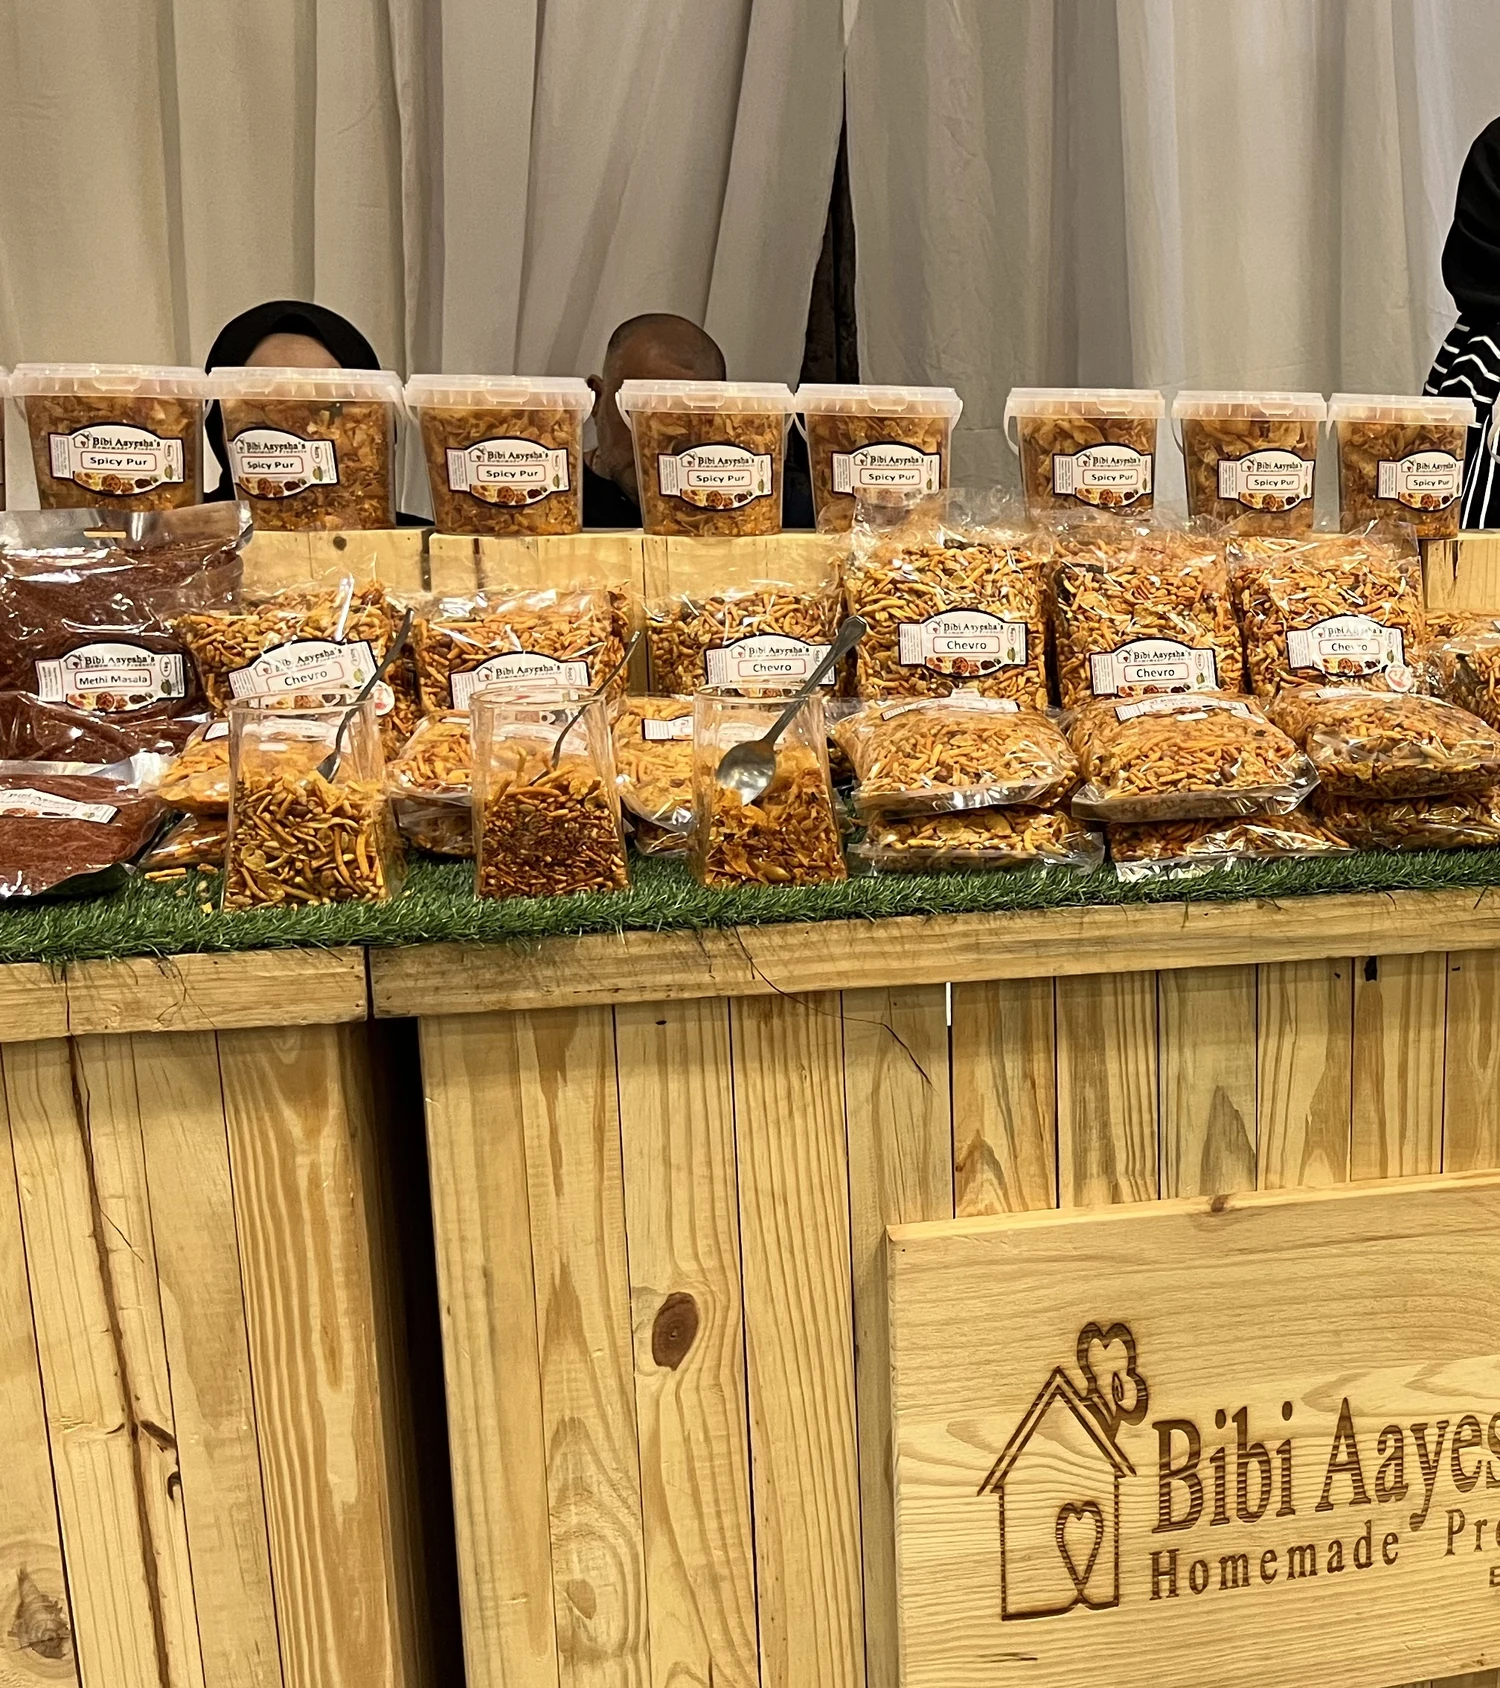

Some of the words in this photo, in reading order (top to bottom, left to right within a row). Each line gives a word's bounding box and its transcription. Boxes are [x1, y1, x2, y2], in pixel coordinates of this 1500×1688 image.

[92, 437, 112, 447] Bibi
[114, 439, 161, 450] Aayesha's
[246, 442, 261, 450] Bibi
[263, 442, 306, 452] Aayesha's
[90, 457, 122, 466] Spicy
[487, 451, 506, 460] Bibi
[507, 451, 549, 462] Aayesha's
[698, 457, 715, 465] Bibi
[717, 456, 755, 467] Aayesha's
[870, 456, 887, 464] Bibi
[247, 461, 272, 470] Spicy
[486, 470, 516, 478] Spicy
[696, 475, 725, 483] Spicy
[868, 473, 896, 481] Spicy
[1254, 479, 1279, 487] Spicy
[1413, 479, 1436, 487] Spicy
[943, 623, 961, 632] Bibi
[962, 623, 1004, 633] Aayesha's
[946, 640, 987, 650] Chevro
[296, 648, 343, 664] Aayesha's
[749, 647, 766, 655] Bibi
[769, 646, 810, 657] Aayesha's
[1134, 651, 1151, 660] Bibi
[1152, 650, 1191, 661] Aayesha's
[85, 656, 104, 665] Bibi
[108, 655, 155, 667] Aayesha's
[495, 667, 514, 677] Bibi
[515, 664, 560, 676] Aayesha's
[753, 663, 792, 672] Chevro
[284, 669, 328, 686] Chevro
[1136, 668, 1175, 678] Chevro
[79, 676, 108, 685] Methi
[110, 675, 148, 683] Masala
[1151, 1400, 1296, 1534] Bibi
[1149, 1519, 1399, 1601] Homemade
